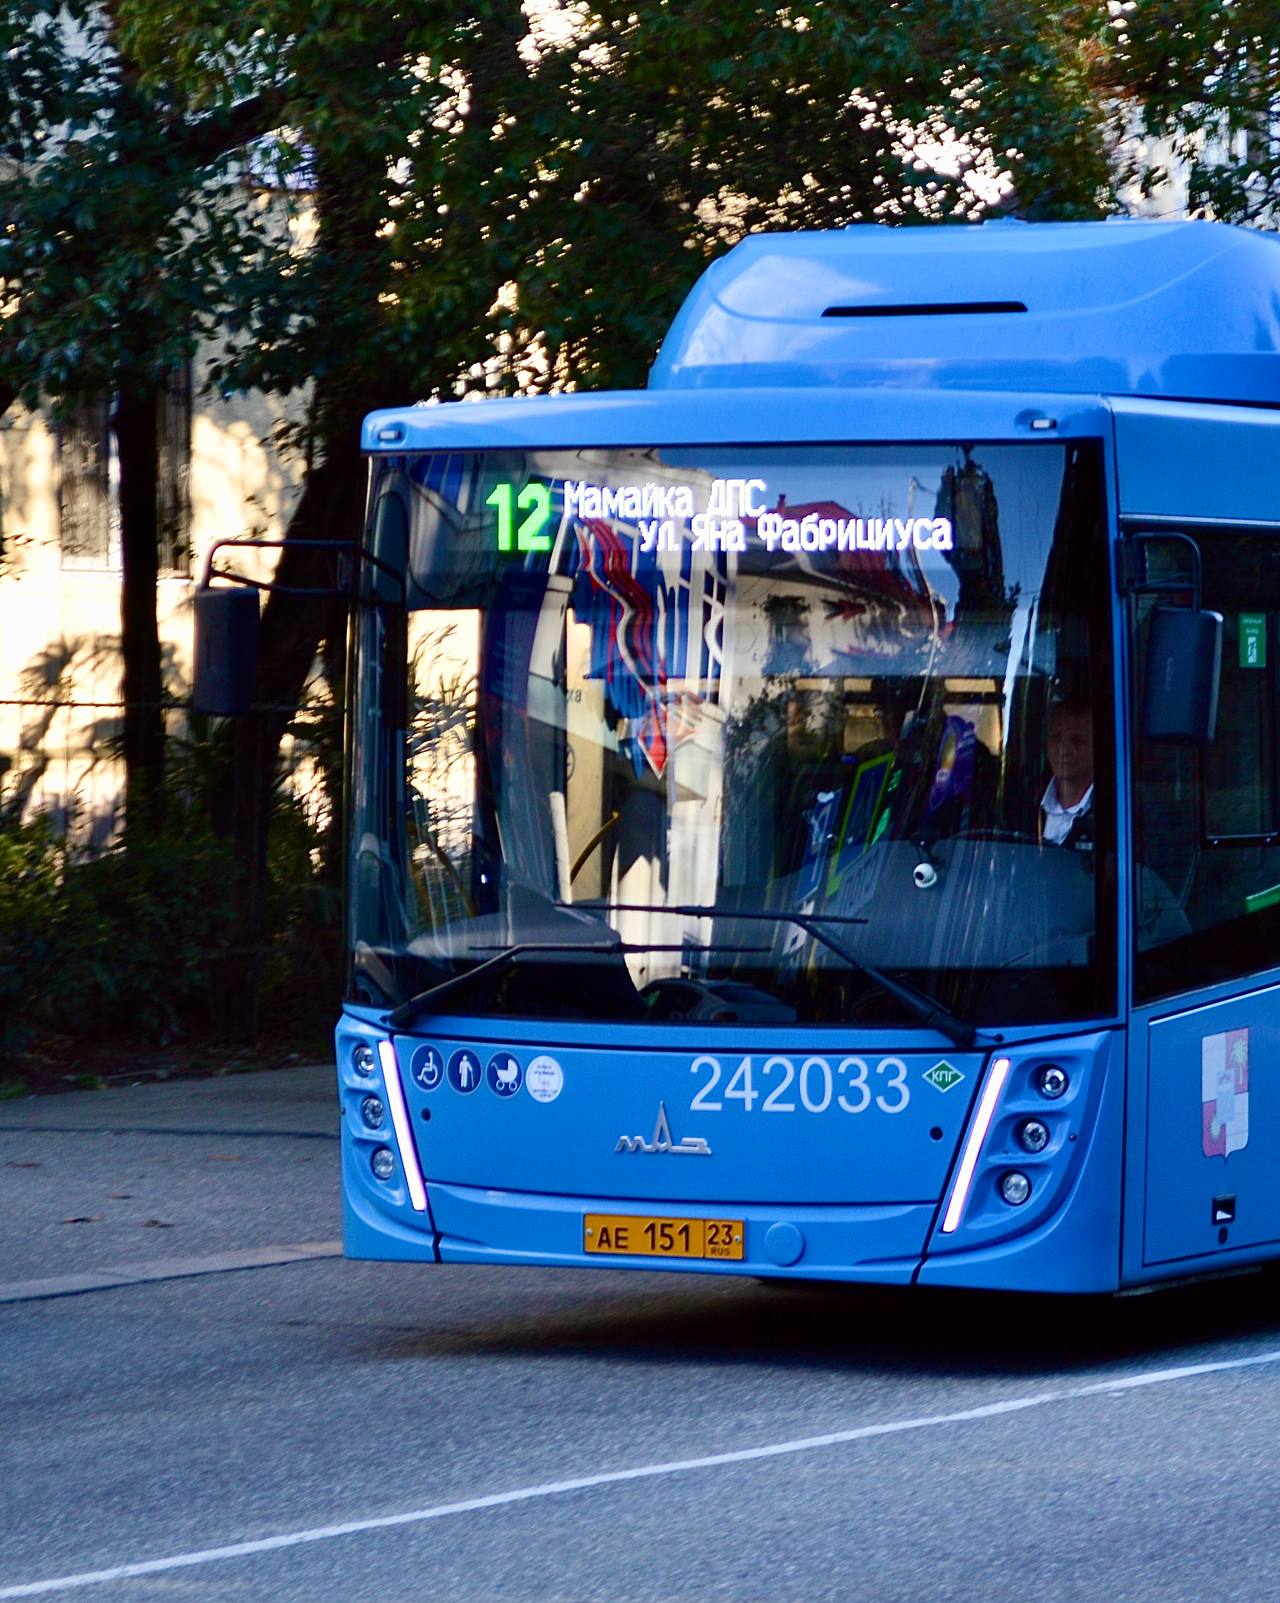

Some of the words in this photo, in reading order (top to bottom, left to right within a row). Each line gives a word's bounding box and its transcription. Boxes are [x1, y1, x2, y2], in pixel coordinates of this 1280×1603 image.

[486, 483, 551, 551] 12
[563, 480, 694, 518] Мамайка
[706, 478, 766, 518] ДПС
[639, 520, 680, 552] ул.
[691, 513, 746, 551] Яна
[757, 512, 953, 552] Фабрициуса
[689, 1055, 911, 1114] 242033
[931, 1070, 955, 1083] КПГ
[643, 1221, 690, 1252] 151
[707, 1223, 733, 1246] 23
[710, 1247, 731, 1256] RUS
